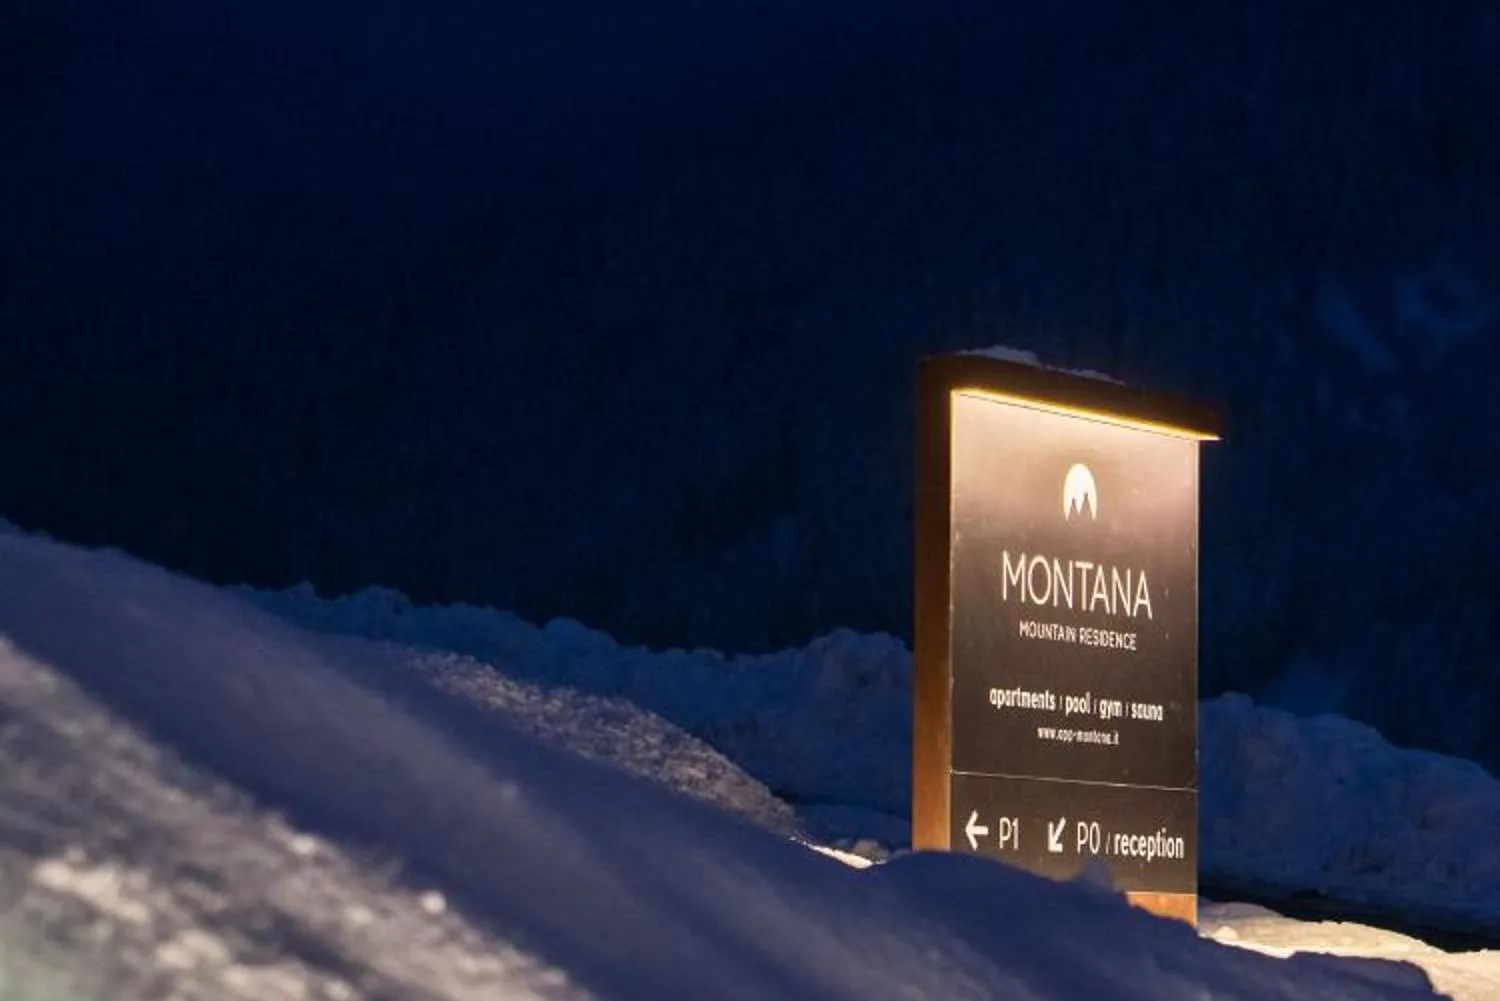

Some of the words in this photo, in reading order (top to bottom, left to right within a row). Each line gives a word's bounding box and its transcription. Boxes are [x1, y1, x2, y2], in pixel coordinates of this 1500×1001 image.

[1002, 550, 1153, 619] MONTANA
[1019, 620, 1076, 643] MOUNTAIN
[1079, 626, 1137, 650] RESIDENCE
[989, 687, 1056, 711] apartments
[1065, 692, 1091, 716] pool
[1099, 699, 1123, 719] gym
[1131, 704, 1164, 721] sauna
[1000, 817, 1019, 849] P1
[1114, 828, 1185, 861] reception
